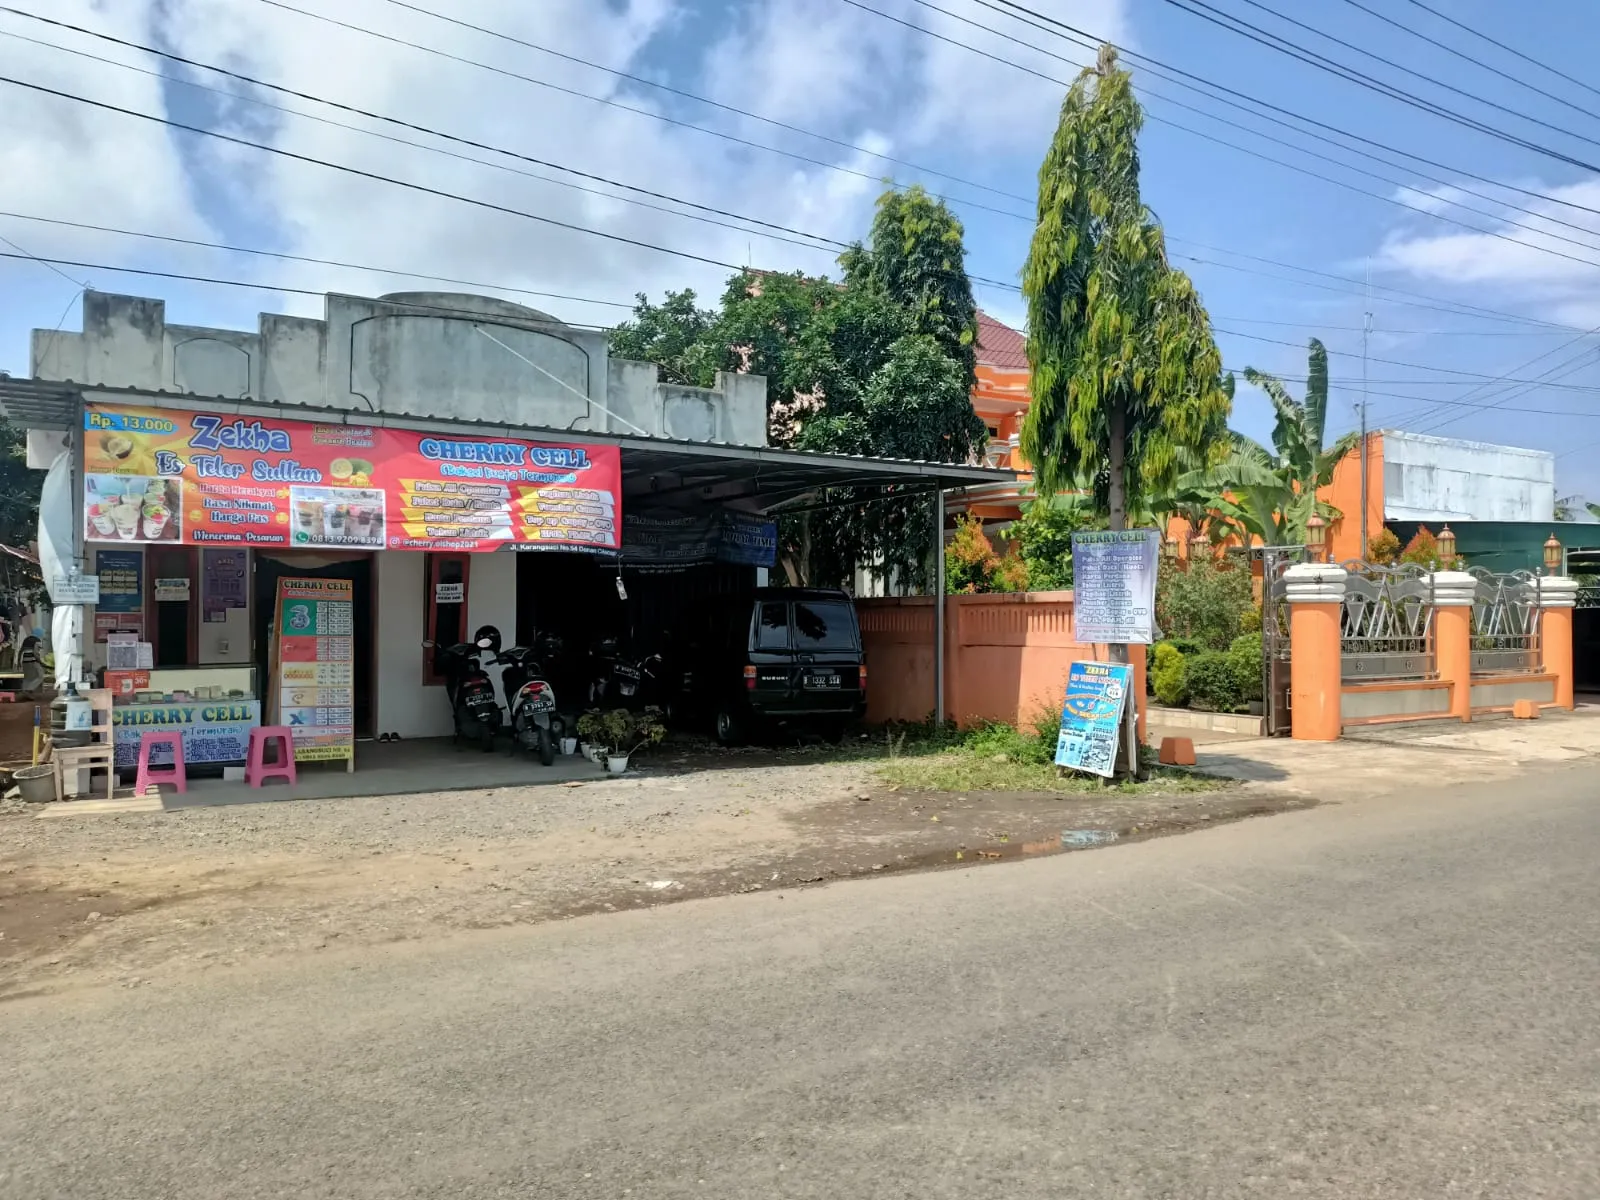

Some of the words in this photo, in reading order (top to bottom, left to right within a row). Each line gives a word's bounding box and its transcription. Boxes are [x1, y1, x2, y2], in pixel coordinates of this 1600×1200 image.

[91, 413, 115, 428] Rp.
[122, 416, 174, 431] 13.000
[189, 415, 291, 453] Zekha
[420, 438, 527, 465] CHERRY
[531, 448, 592, 470] CELL
[155, 450, 184, 475] Es
[190, 454, 246, 478] Teler
[252, 459, 322, 482] Sultan
[203, 497, 232, 508] Rasa
[211, 510, 245, 524] Harga
[247, 512, 269, 523] Pas
[193, 529, 242, 540] Menerima
[245, 532, 284, 542] Pesanan
[1075, 533, 1116, 544] CHERRY
[1119, 531, 1147, 543] CELL
[284, 580, 324, 589] CHERRY
[326, 582, 350, 590] CELL
[201, 704, 252, 722] CELL
